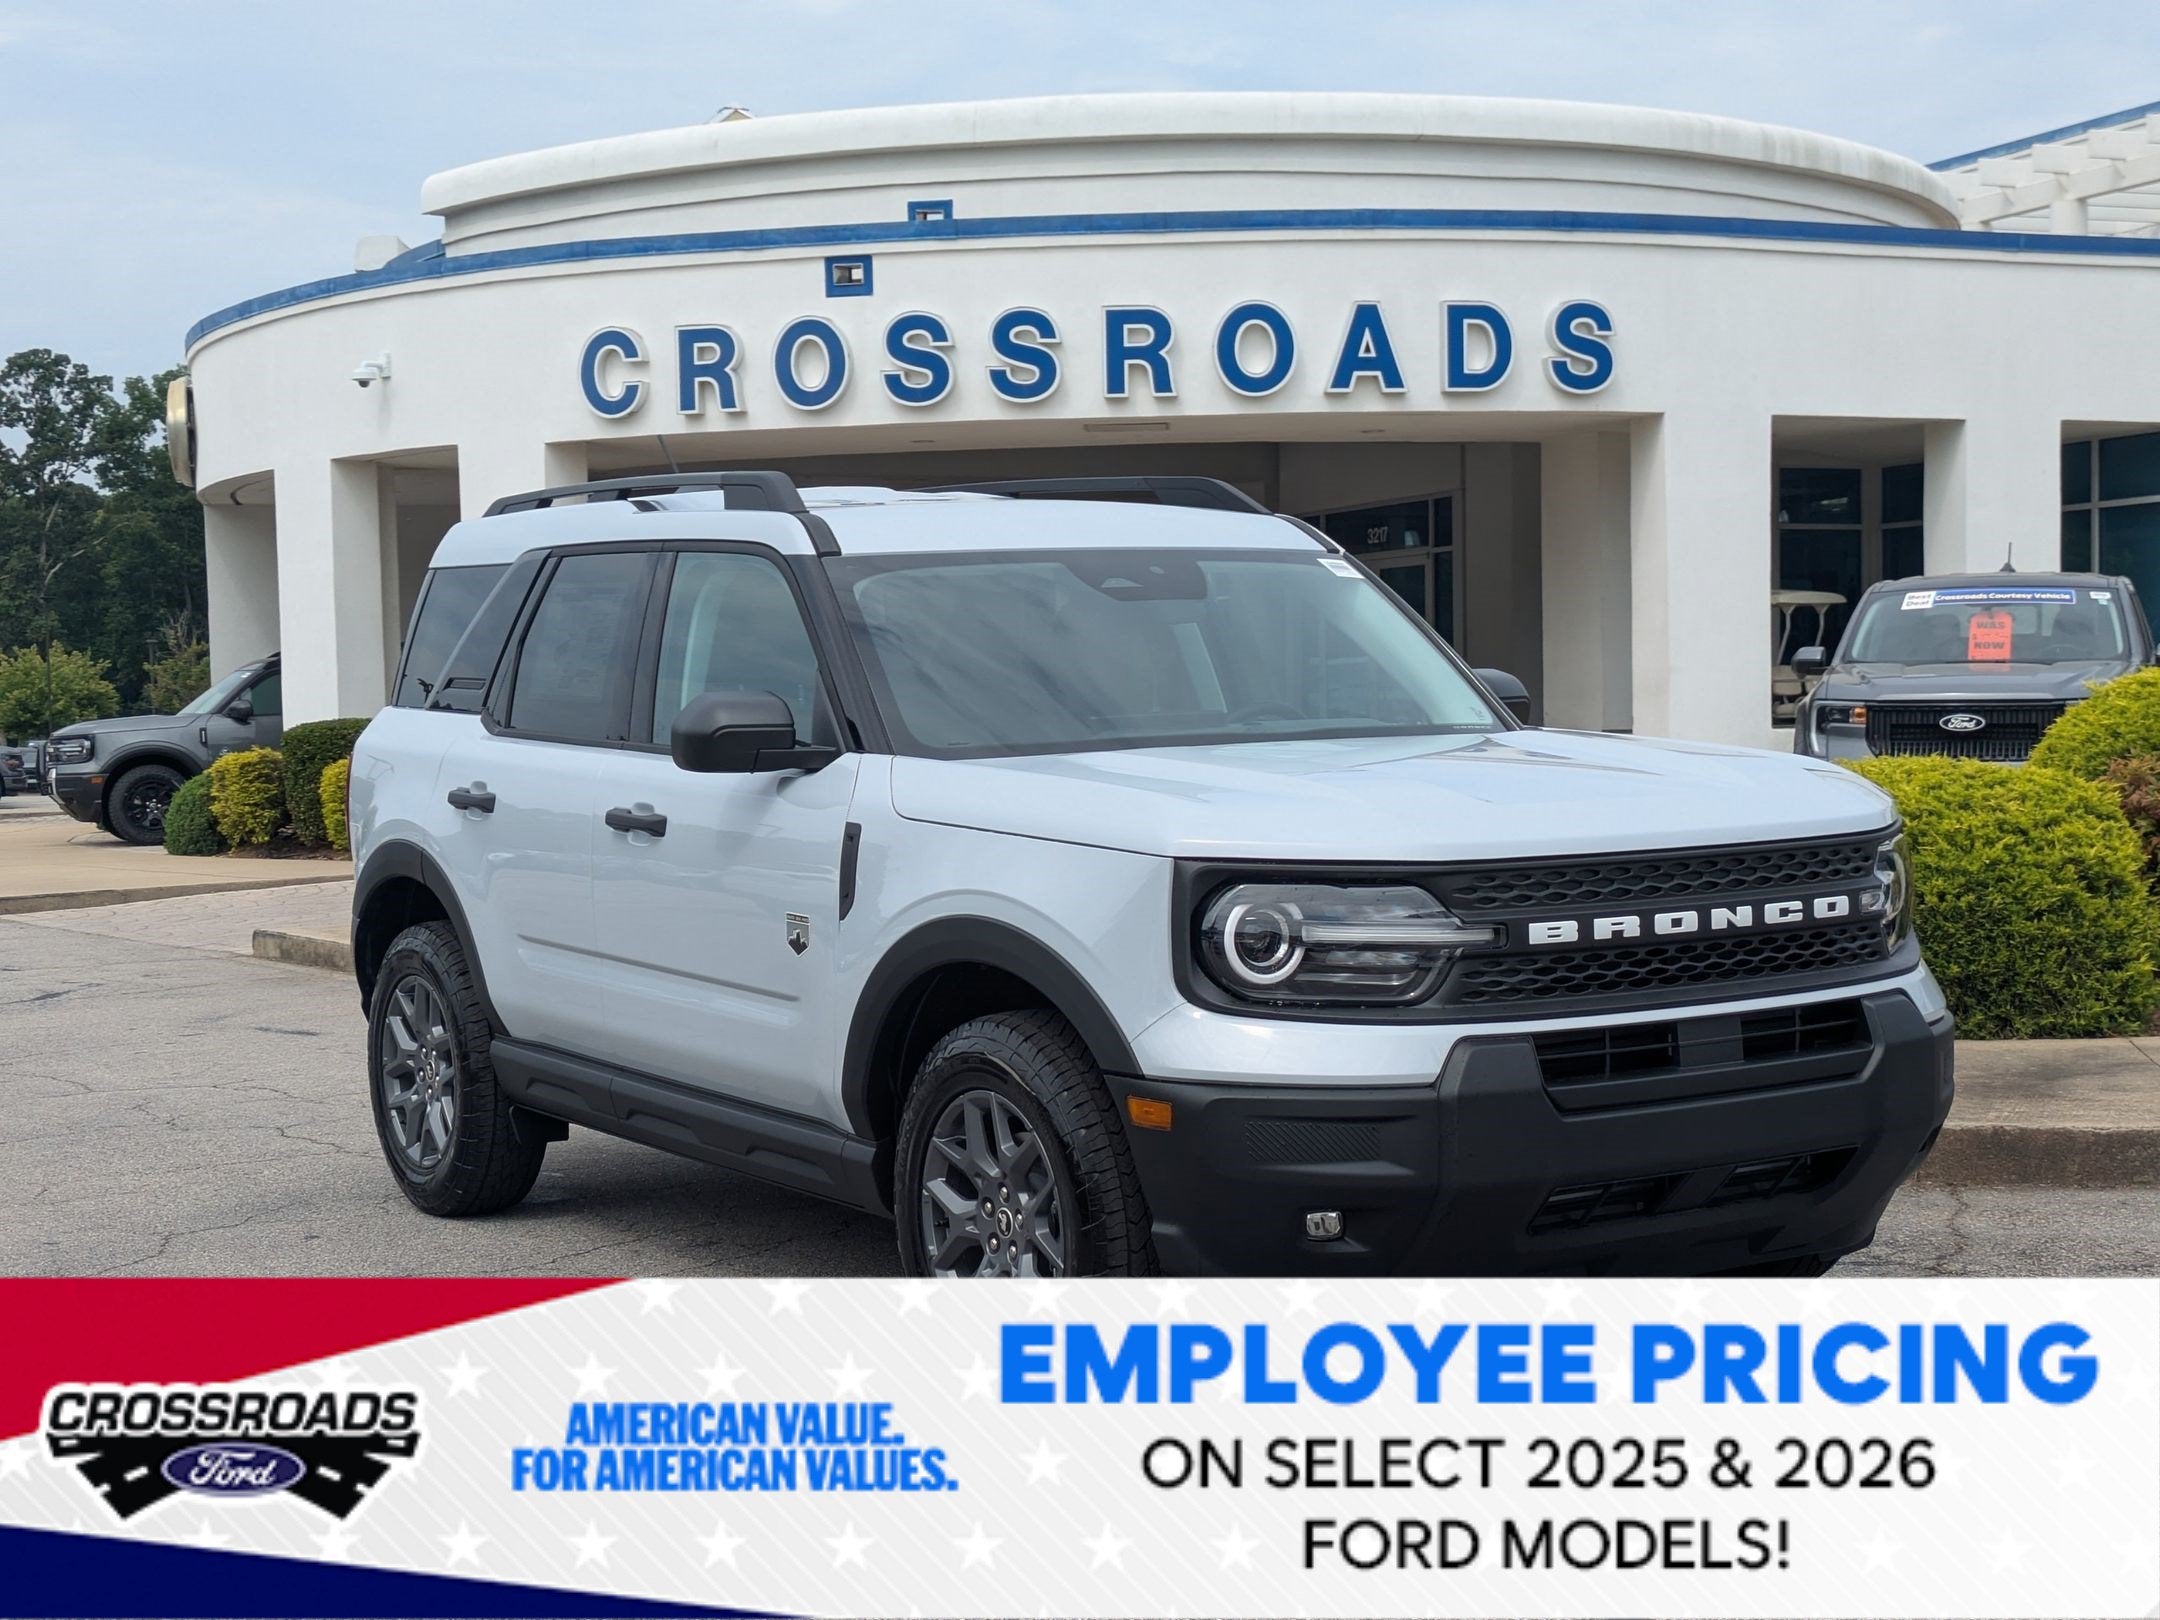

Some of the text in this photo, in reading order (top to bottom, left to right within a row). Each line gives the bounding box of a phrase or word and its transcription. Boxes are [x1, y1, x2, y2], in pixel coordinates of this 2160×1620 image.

[580, 300, 1615, 419] CROSSROADS
[1367, 526, 1388, 544] 3217
[1988, 592, 2032, 600] Courtesy
[1977, 621, 2005, 629] WAS
[1974, 641, 2005, 649] NOW
[1948, 717, 1976, 728] Ford
[1528, 895, 1850, 945] BRONCO
